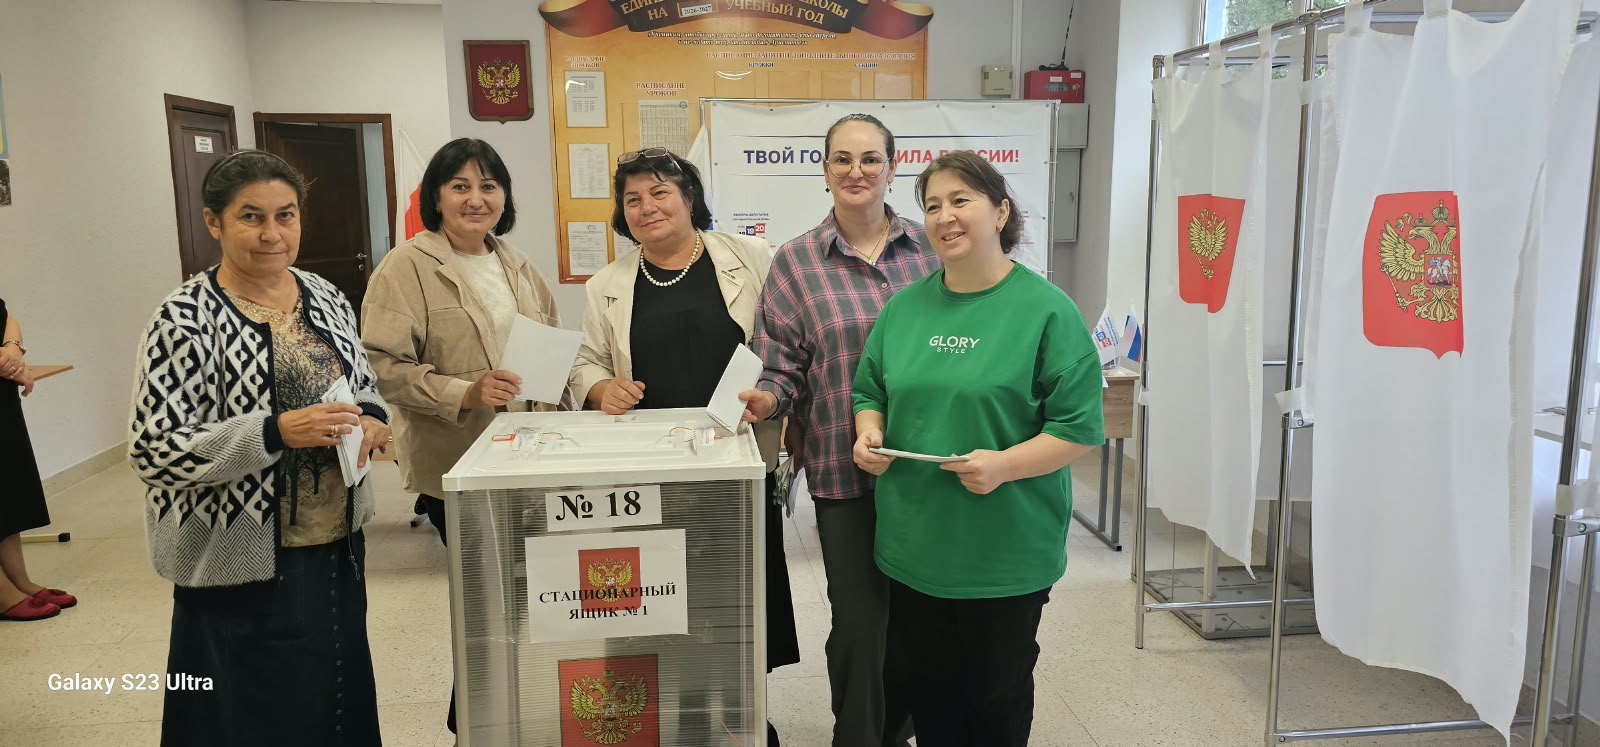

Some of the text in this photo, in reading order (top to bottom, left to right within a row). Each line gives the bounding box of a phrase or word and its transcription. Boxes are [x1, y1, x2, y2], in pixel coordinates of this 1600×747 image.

[648, 7, 669, 20] НА
[727, 0, 793, 16] УЧЕБНЫЙ
[797, 7, 825, 24] ГОД
[743, 146, 794, 164] ТВОЙ
[929, 335, 980, 349] GLORY
[555, 490, 641, 521] № 18
[539, 582, 676, 603] СТАЦИОНАРНЫЙ
[569, 605, 648, 621] ЯЩИК № 1
